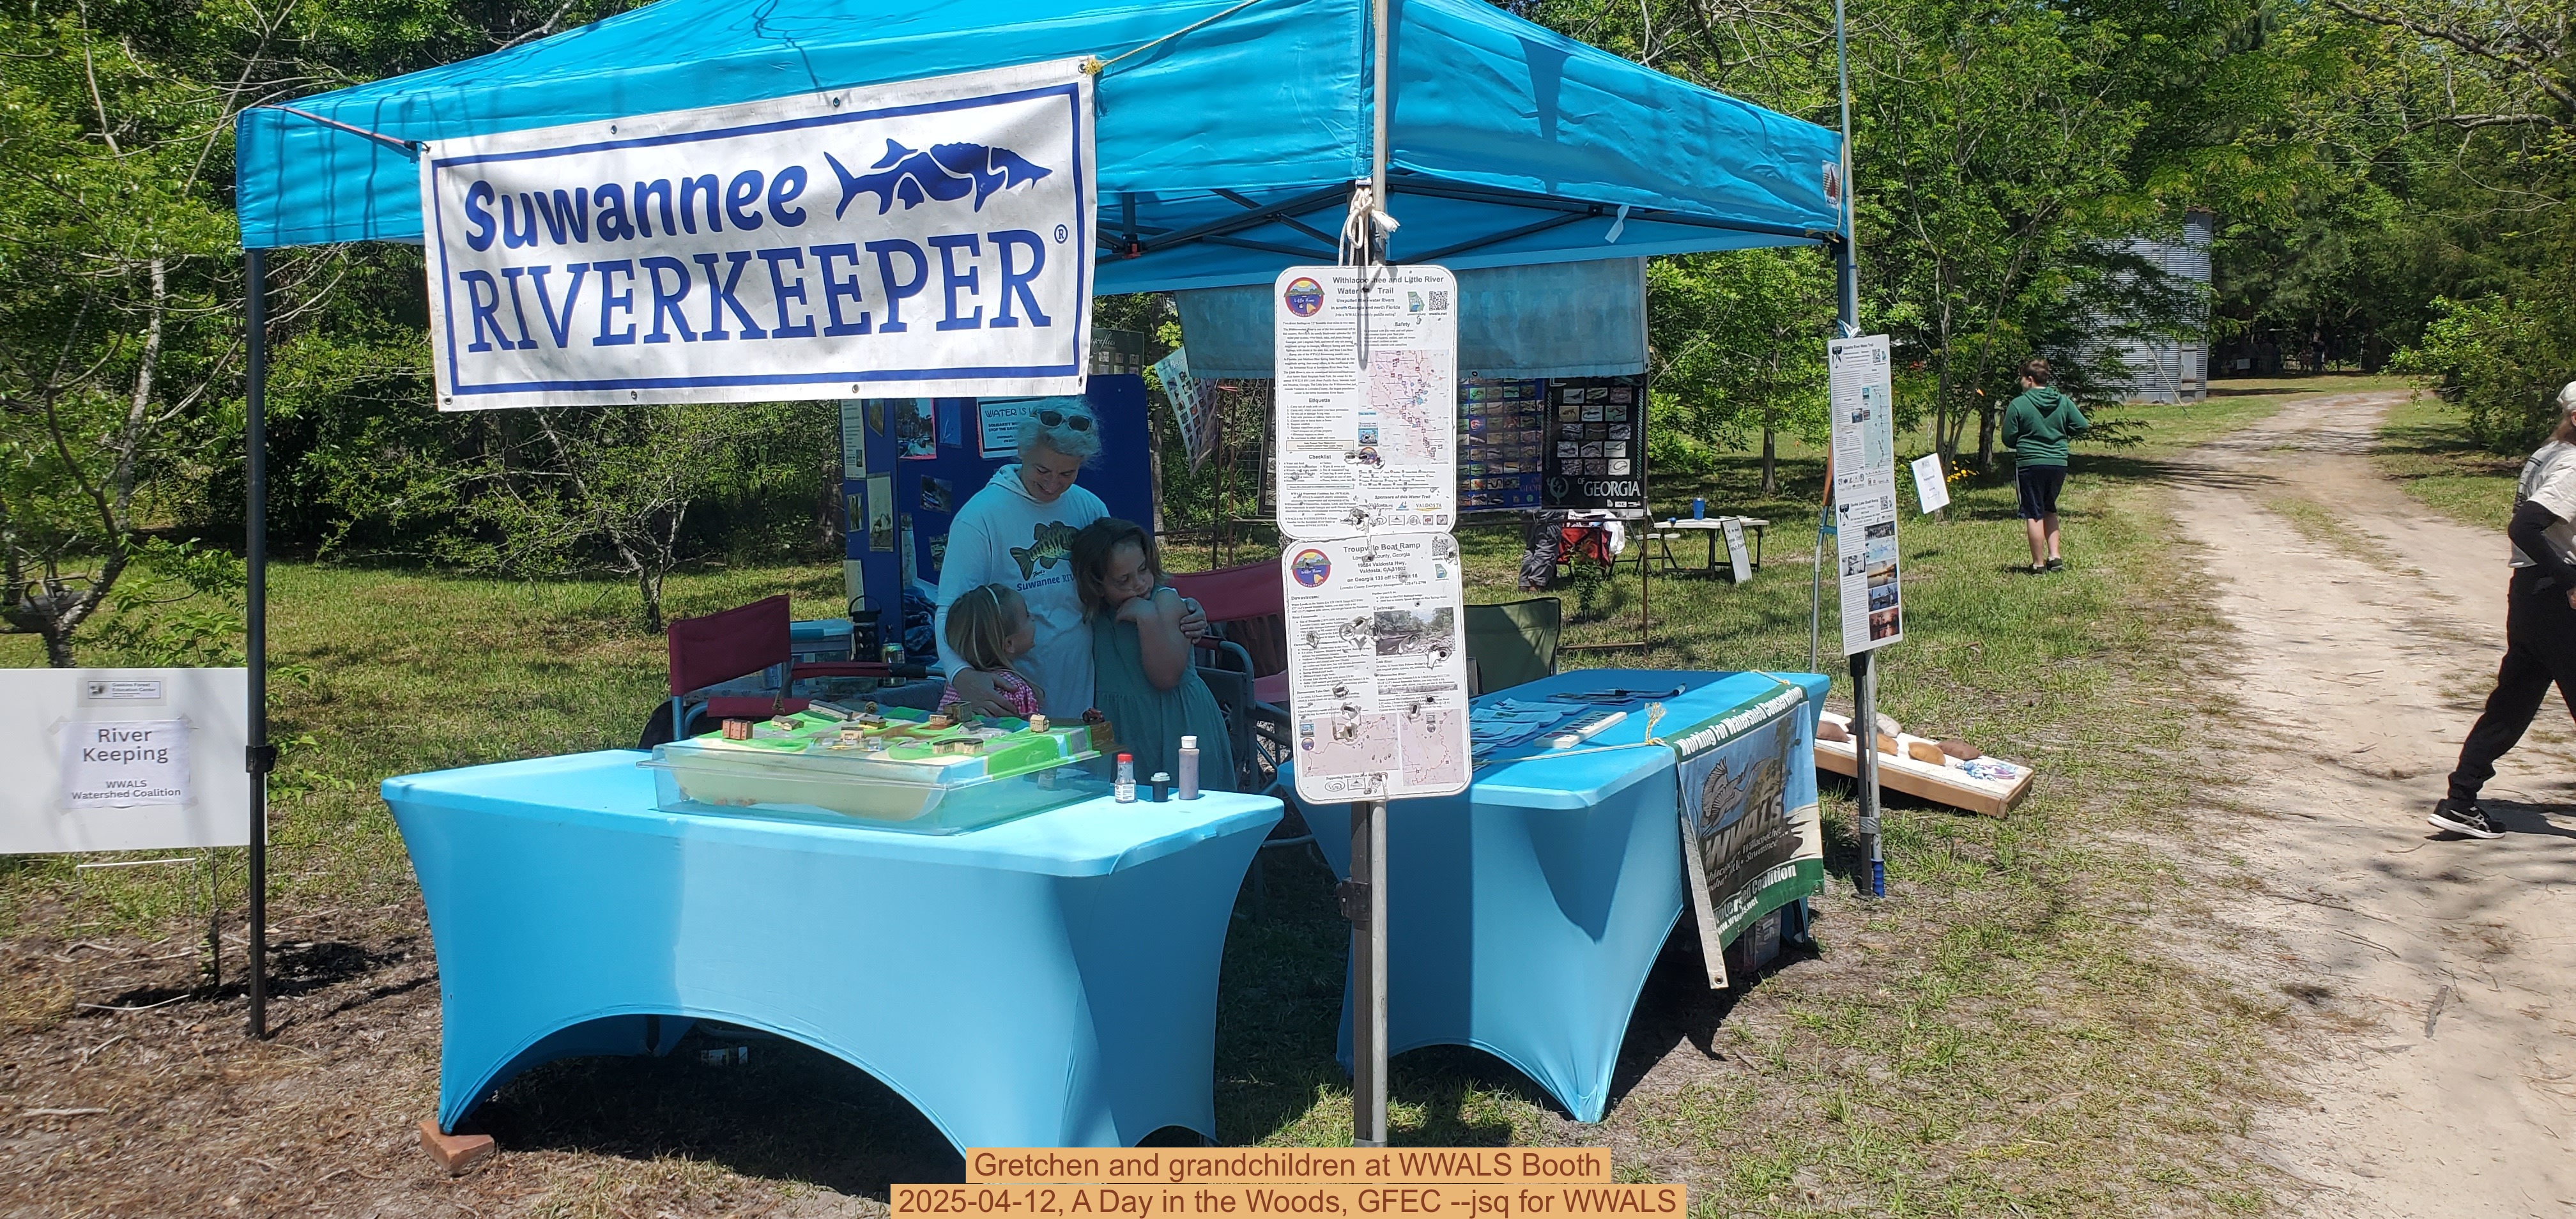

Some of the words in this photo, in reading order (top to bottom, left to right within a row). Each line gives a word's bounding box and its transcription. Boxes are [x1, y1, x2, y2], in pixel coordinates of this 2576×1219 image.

[465, 166, 806, 250] Suwannee
[459, 229, 1051, 352] RIVERKEEPER
[985, 408, 1017, 418] WATER
[1584, 480, 1641, 496] GEORGIA
[1017, 576, 1061, 591] Suwannee
[1722, 705, 1767, 735] Watershed
[98, 728, 152, 742] River
[83, 746, 168, 764] Keeping
[106, 779, 147, 788] WWALS
[72, 790, 130, 799] Watershed
[134, 788, 181, 797] Coalition
[1752, 864, 1797, 894] Coalition
